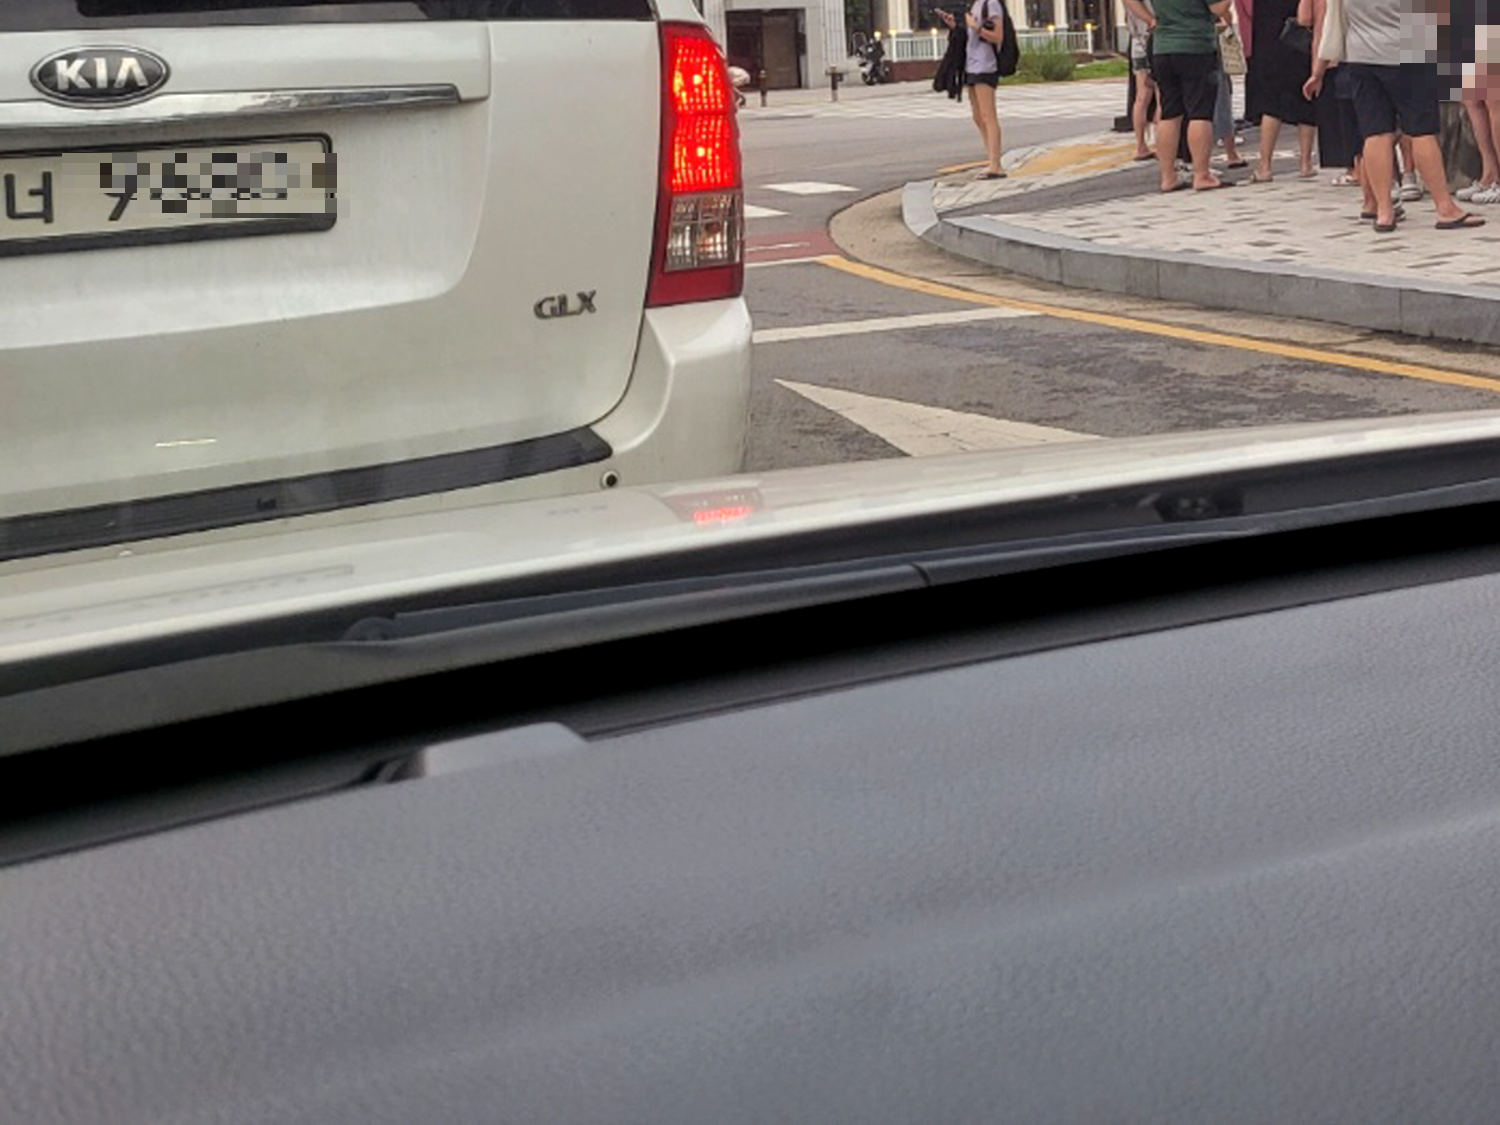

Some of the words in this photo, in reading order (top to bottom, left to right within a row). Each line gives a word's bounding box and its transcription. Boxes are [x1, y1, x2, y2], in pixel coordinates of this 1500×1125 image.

[54, 56, 149, 91] KIA
[4, 170, 54, 224] 너
[533, 289, 597, 320] GLX
